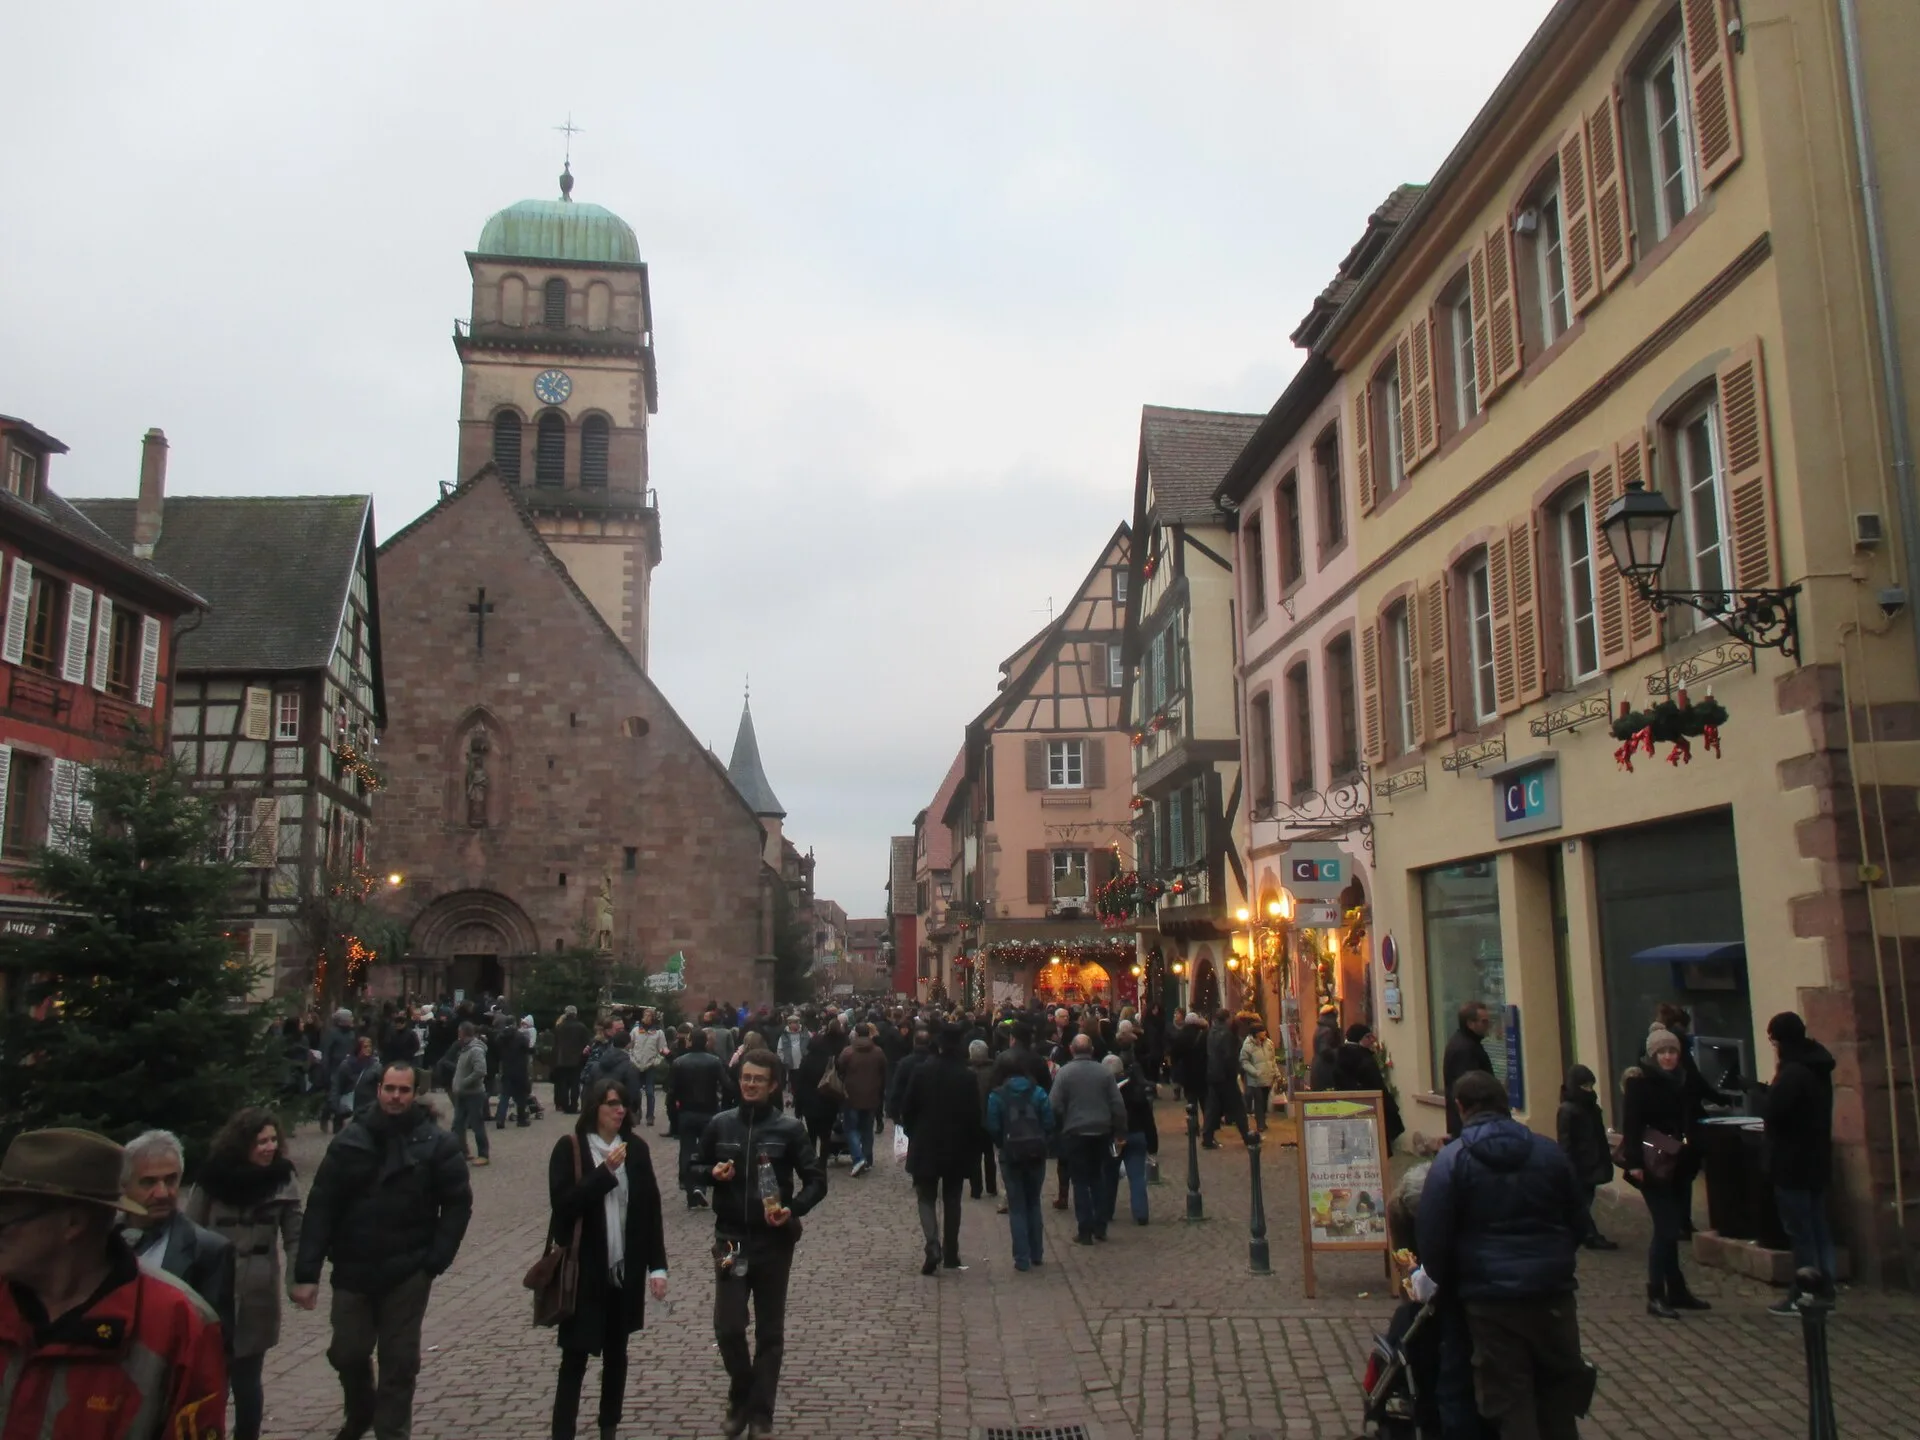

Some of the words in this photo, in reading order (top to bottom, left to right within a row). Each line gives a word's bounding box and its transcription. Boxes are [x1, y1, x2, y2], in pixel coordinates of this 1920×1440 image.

[1508, 779, 1540, 813] CIC
[1297, 863, 1336, 880] CIC
[1310, 1172, 1352, 1181] Auberge
[1364, 1171, 1379, 1179] Bar
